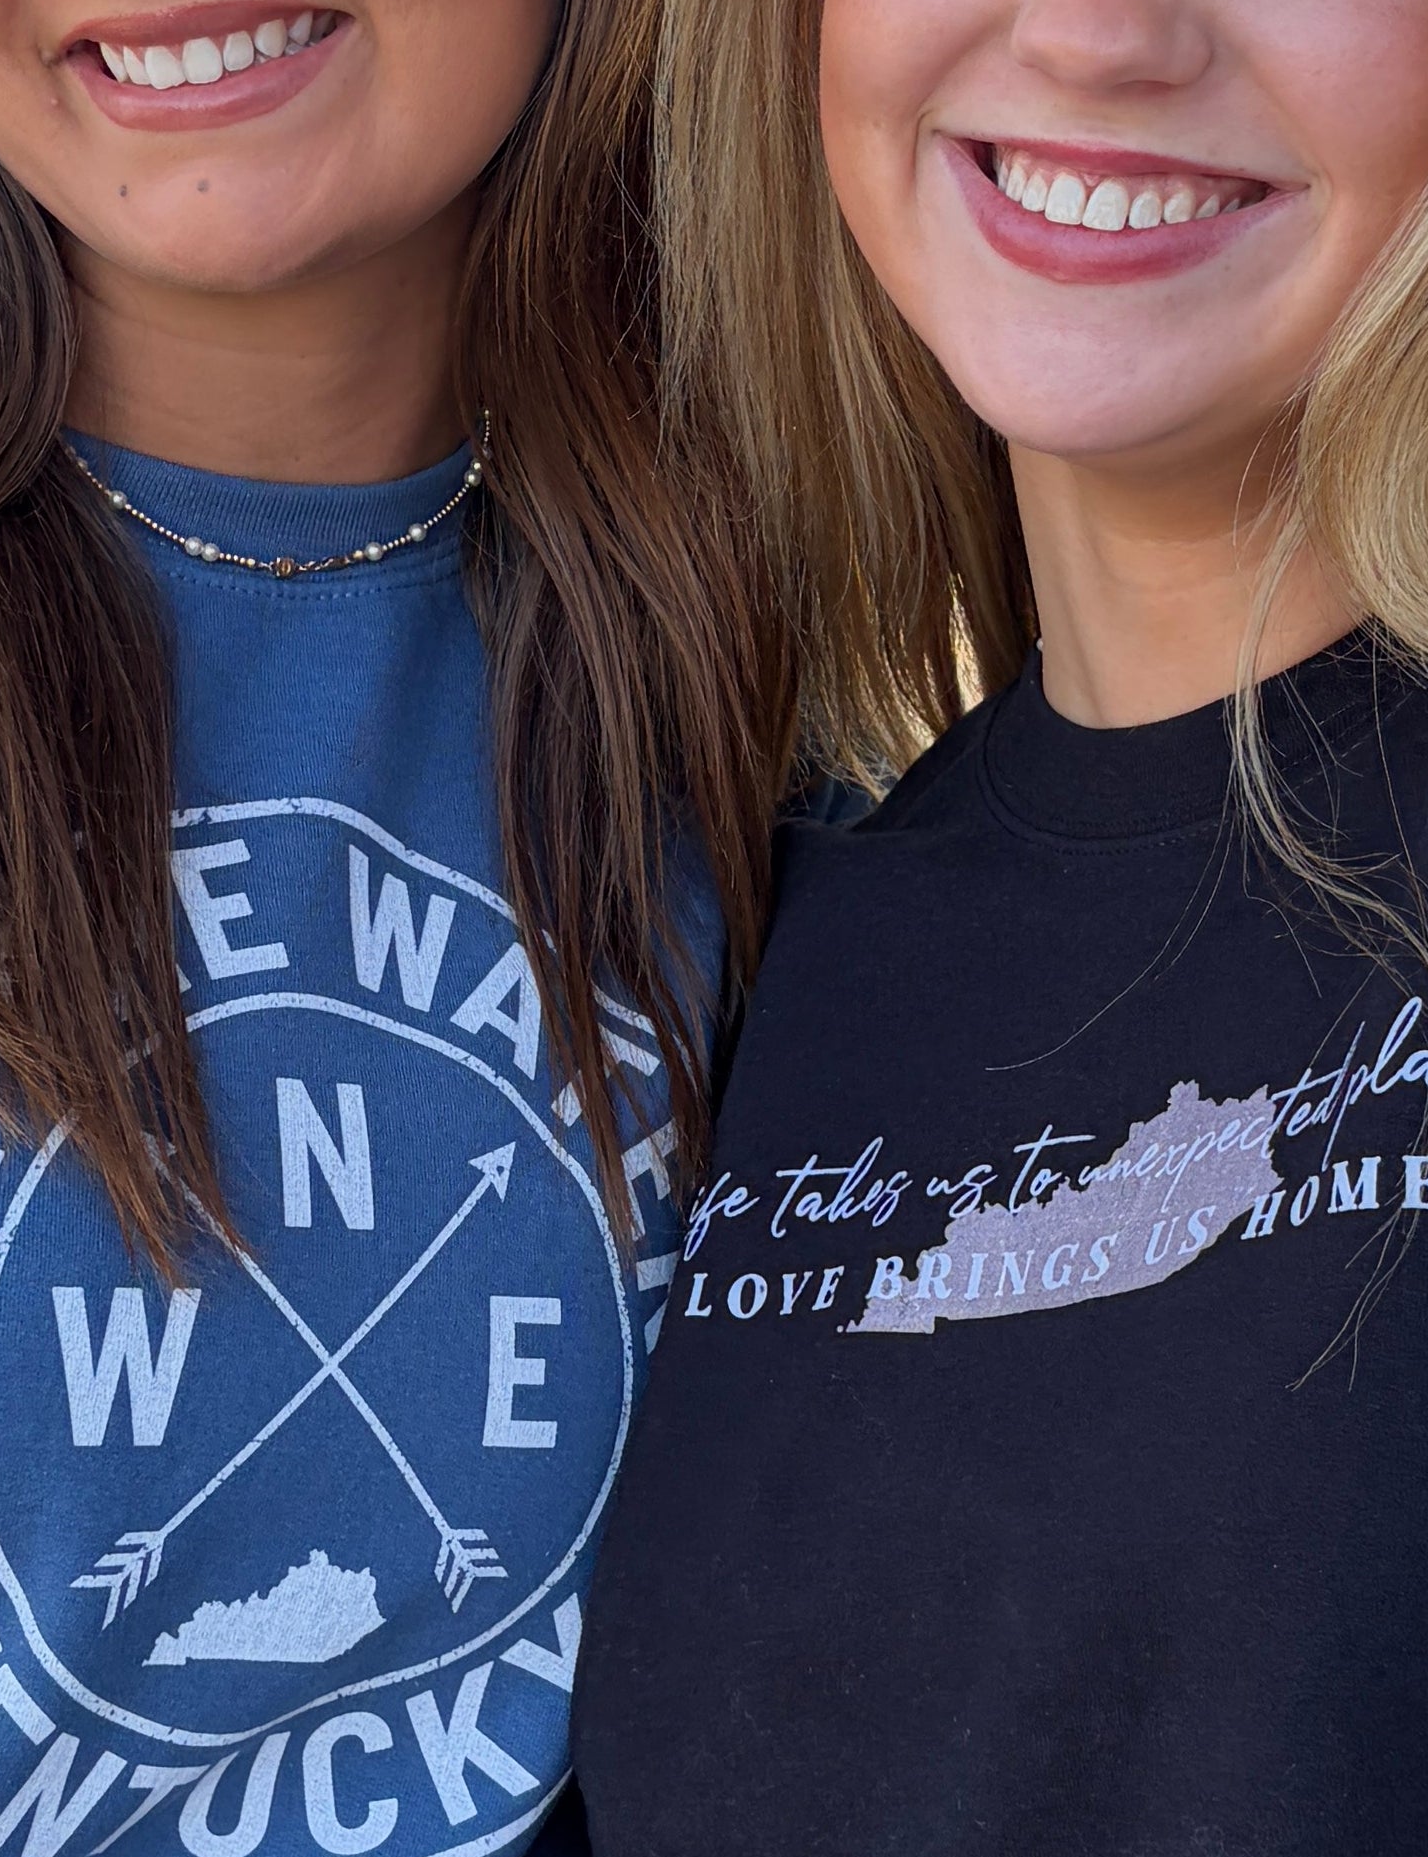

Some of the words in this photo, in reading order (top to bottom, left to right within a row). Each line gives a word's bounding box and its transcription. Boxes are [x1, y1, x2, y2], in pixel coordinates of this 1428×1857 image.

[274, 1077, 374, 1231] N
[683, 1172, 760, 1261] ife
[771, 1137, 912, 1238] takes
[926, 1164, 997, 1218] us
[1009, 1124, 1096, 1216] to
[1078, 1021, 1365, 1213] unexpected
[685, 1265, 845, 1320] LOVE
[865, 1231, 1119, 1301] BRINGS
[1144, 1205, 1216, 1266] US
[51, 1285, 201, 1447] W
[482, 1297, 562, 1449] E
